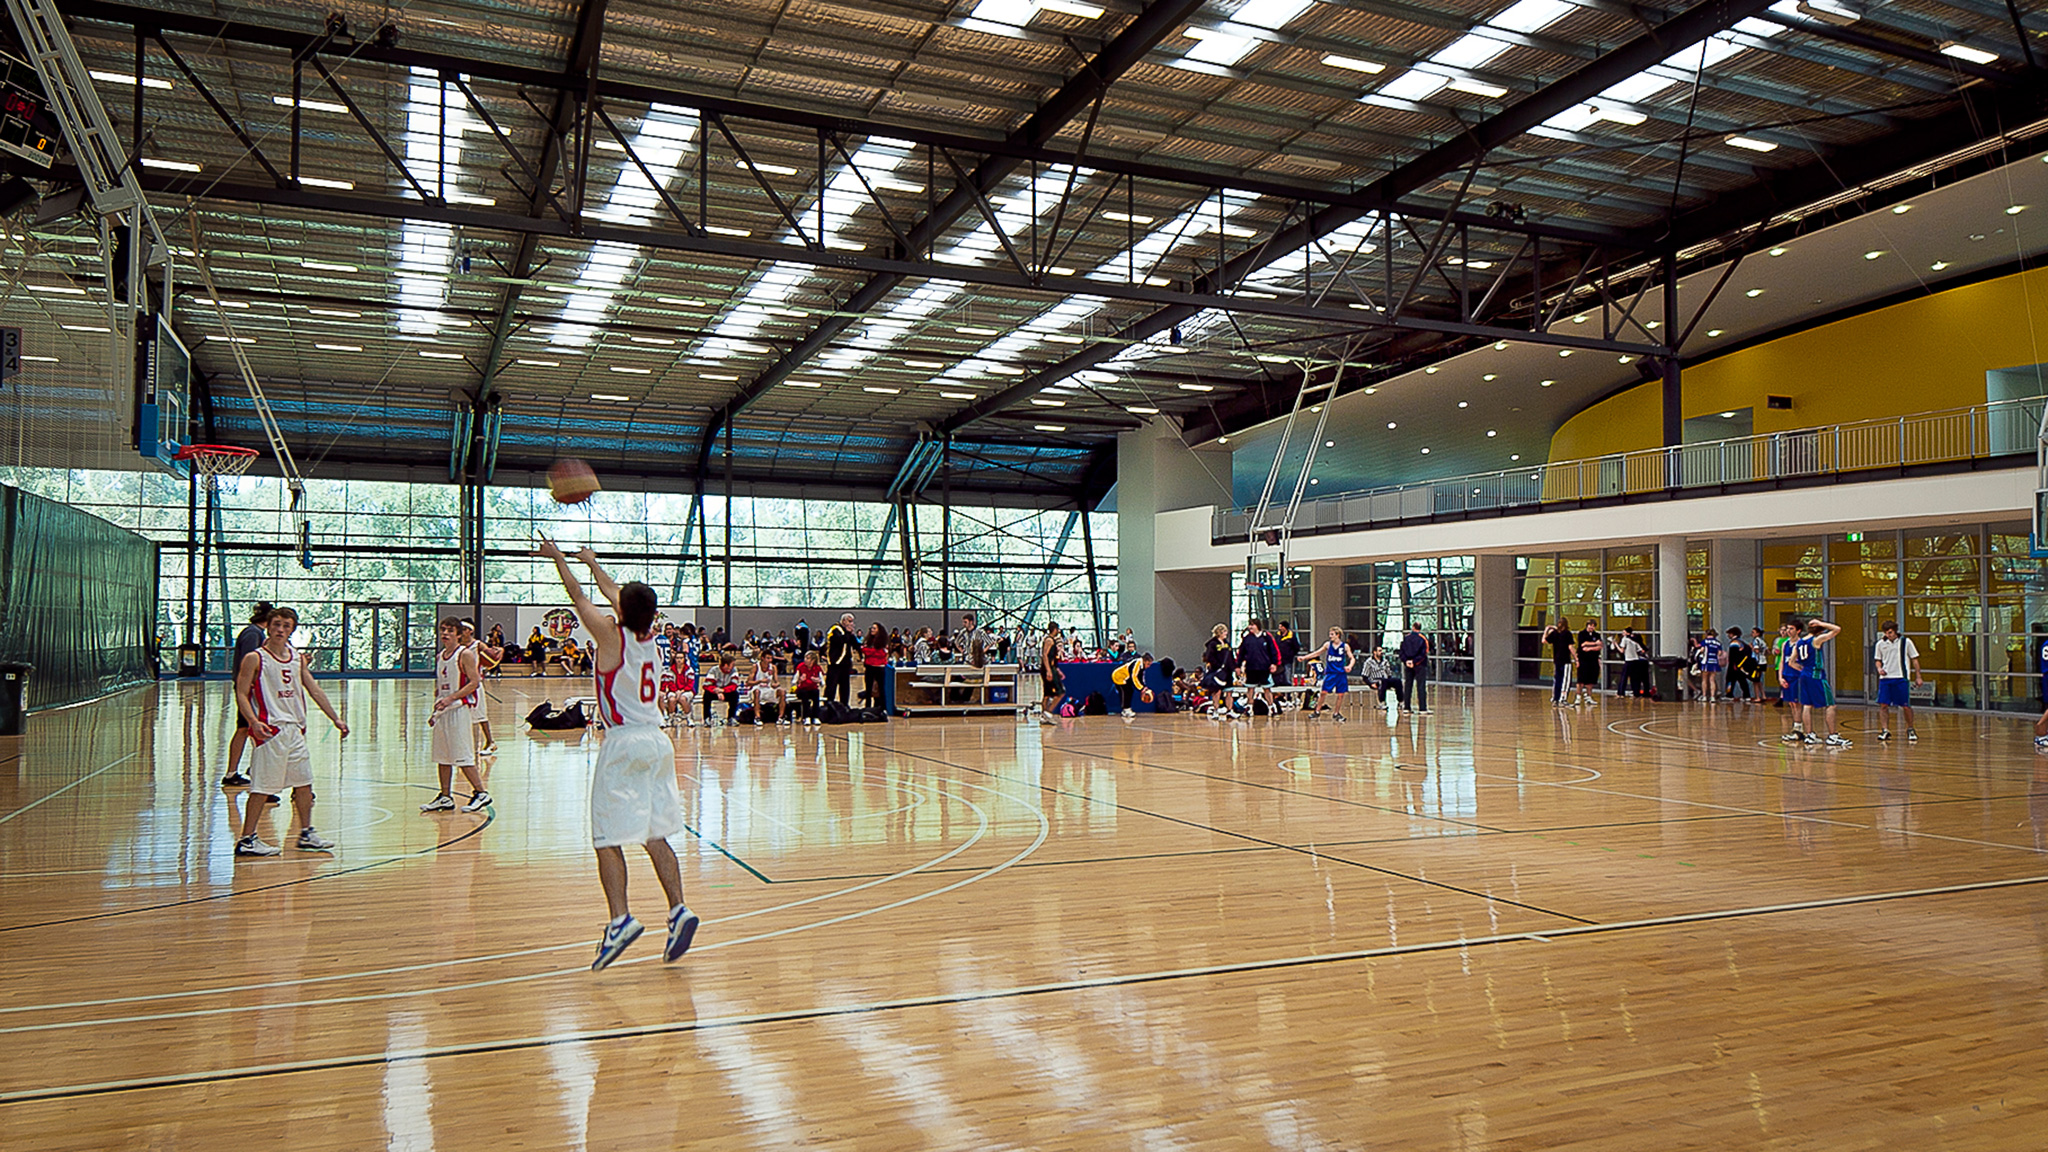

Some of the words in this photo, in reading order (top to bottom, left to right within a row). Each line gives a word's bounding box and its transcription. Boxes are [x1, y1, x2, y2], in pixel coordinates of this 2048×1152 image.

[36, 138, 47, 151] 0
[5, 332, 18, 347] 3
[5, 357, 18, 371] 4
[281, 669, 292, 684] 5
[640, 661, 656, 703] 6
